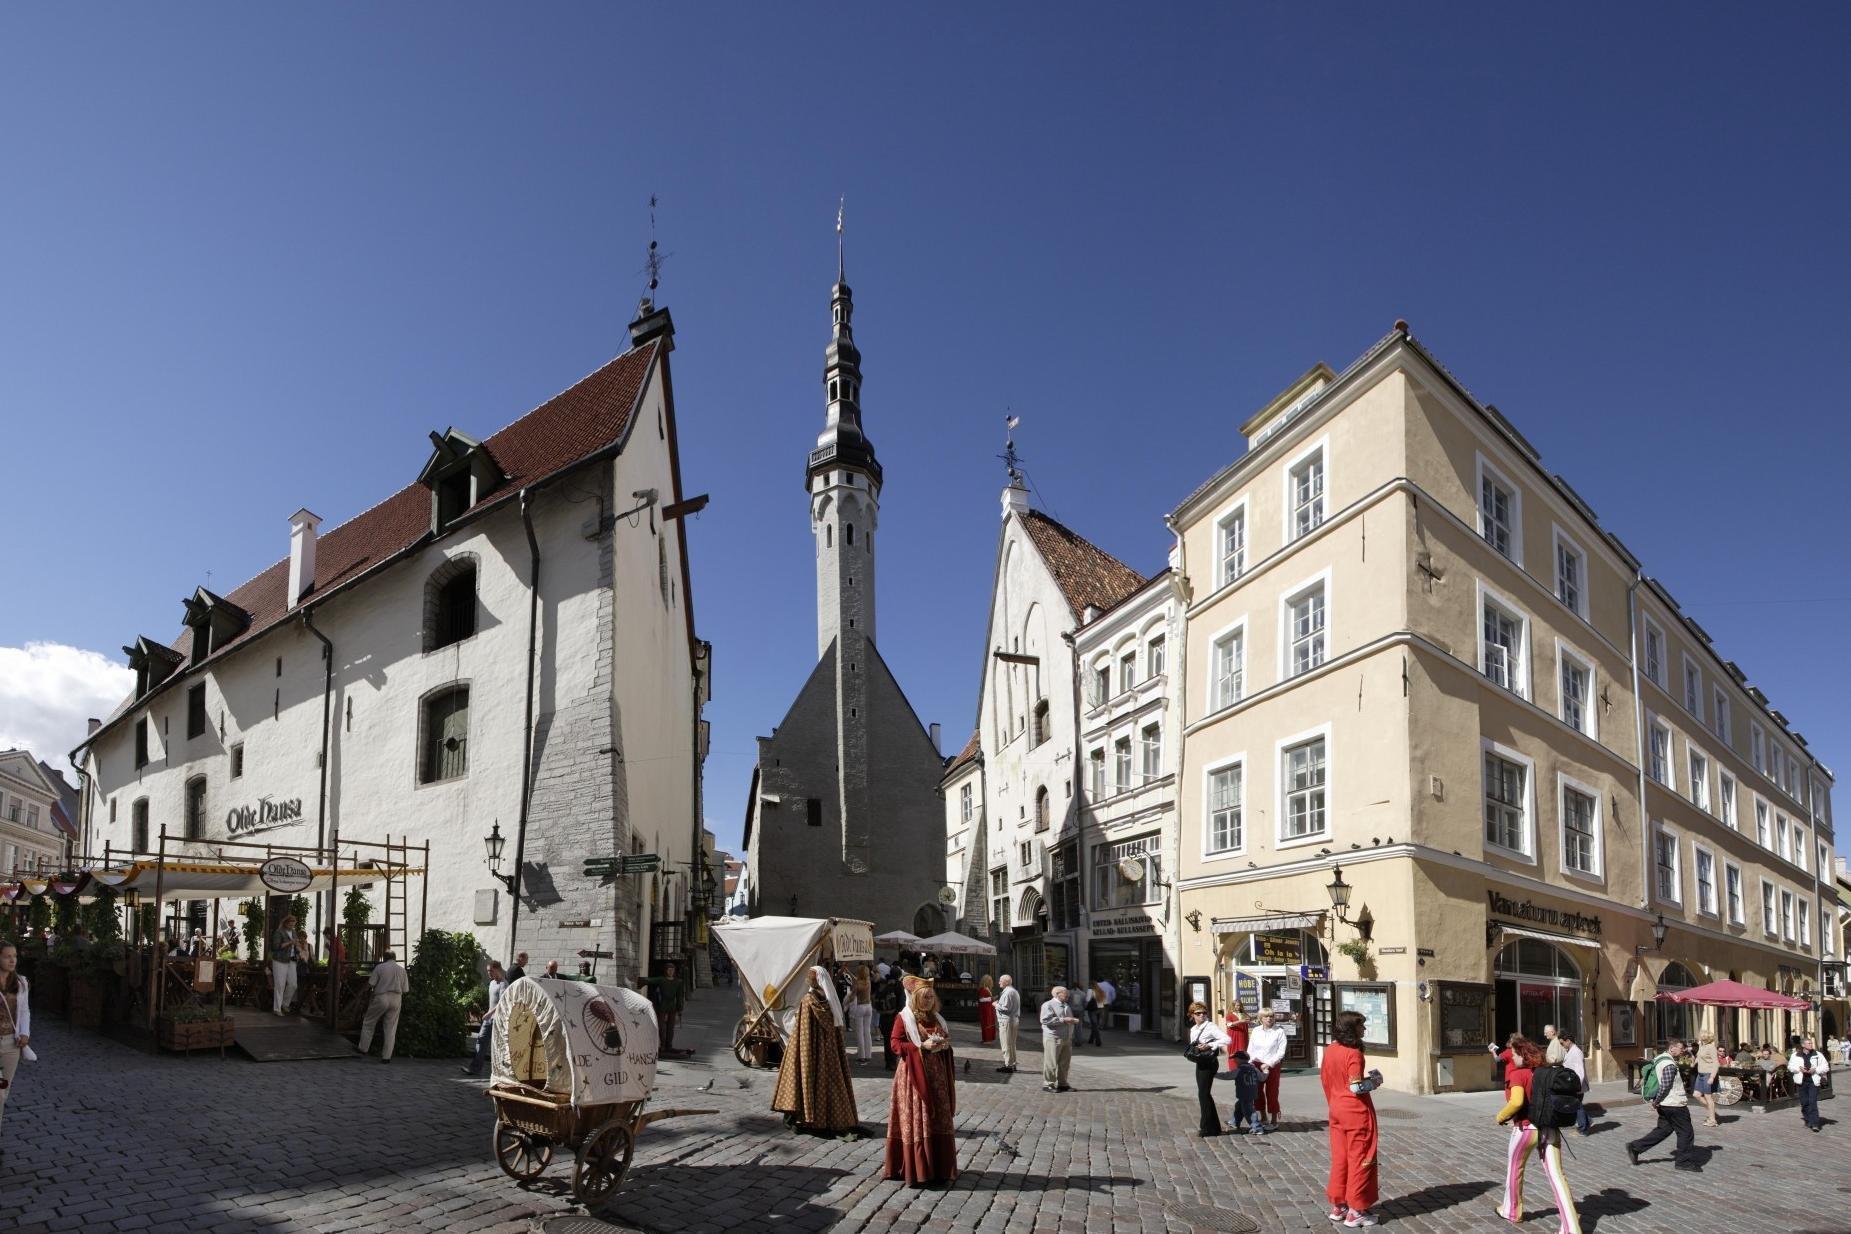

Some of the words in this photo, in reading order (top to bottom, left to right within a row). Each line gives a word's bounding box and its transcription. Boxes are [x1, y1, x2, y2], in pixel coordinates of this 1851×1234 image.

[226, 803, 257, 834] Olde
[256, 793, 302, 825] Hansa
[268, 863, 286, 876] Olde
[285, 864, 307, 877] Hansa
[603, 1072, 628, 1086] GILD
